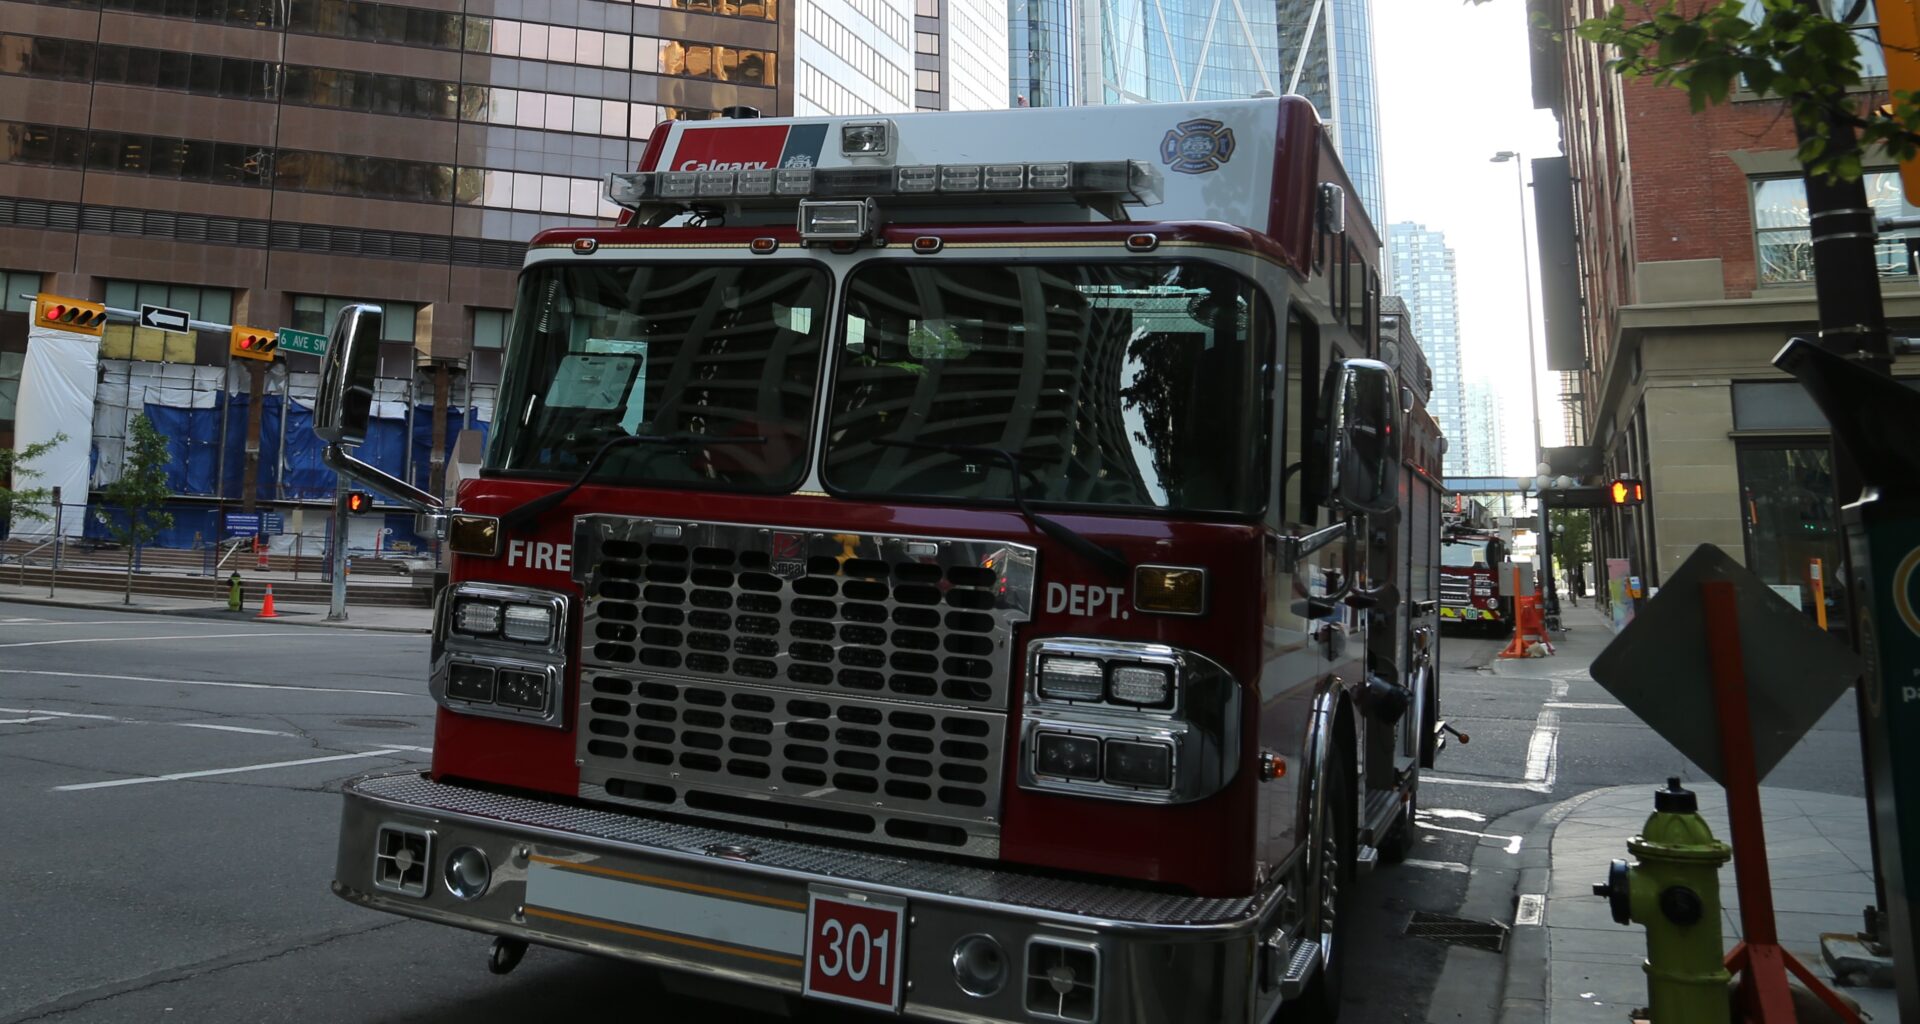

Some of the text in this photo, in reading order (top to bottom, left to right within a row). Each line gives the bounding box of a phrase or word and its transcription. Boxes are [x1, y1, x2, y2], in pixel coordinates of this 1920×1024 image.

[280, 333, 327, 352] 6 AVE SW
[507, 539, 572, 572] FIRE
[1045, 582, 1129, 620] DEPT.
[818, 917, 890, 987] 301
